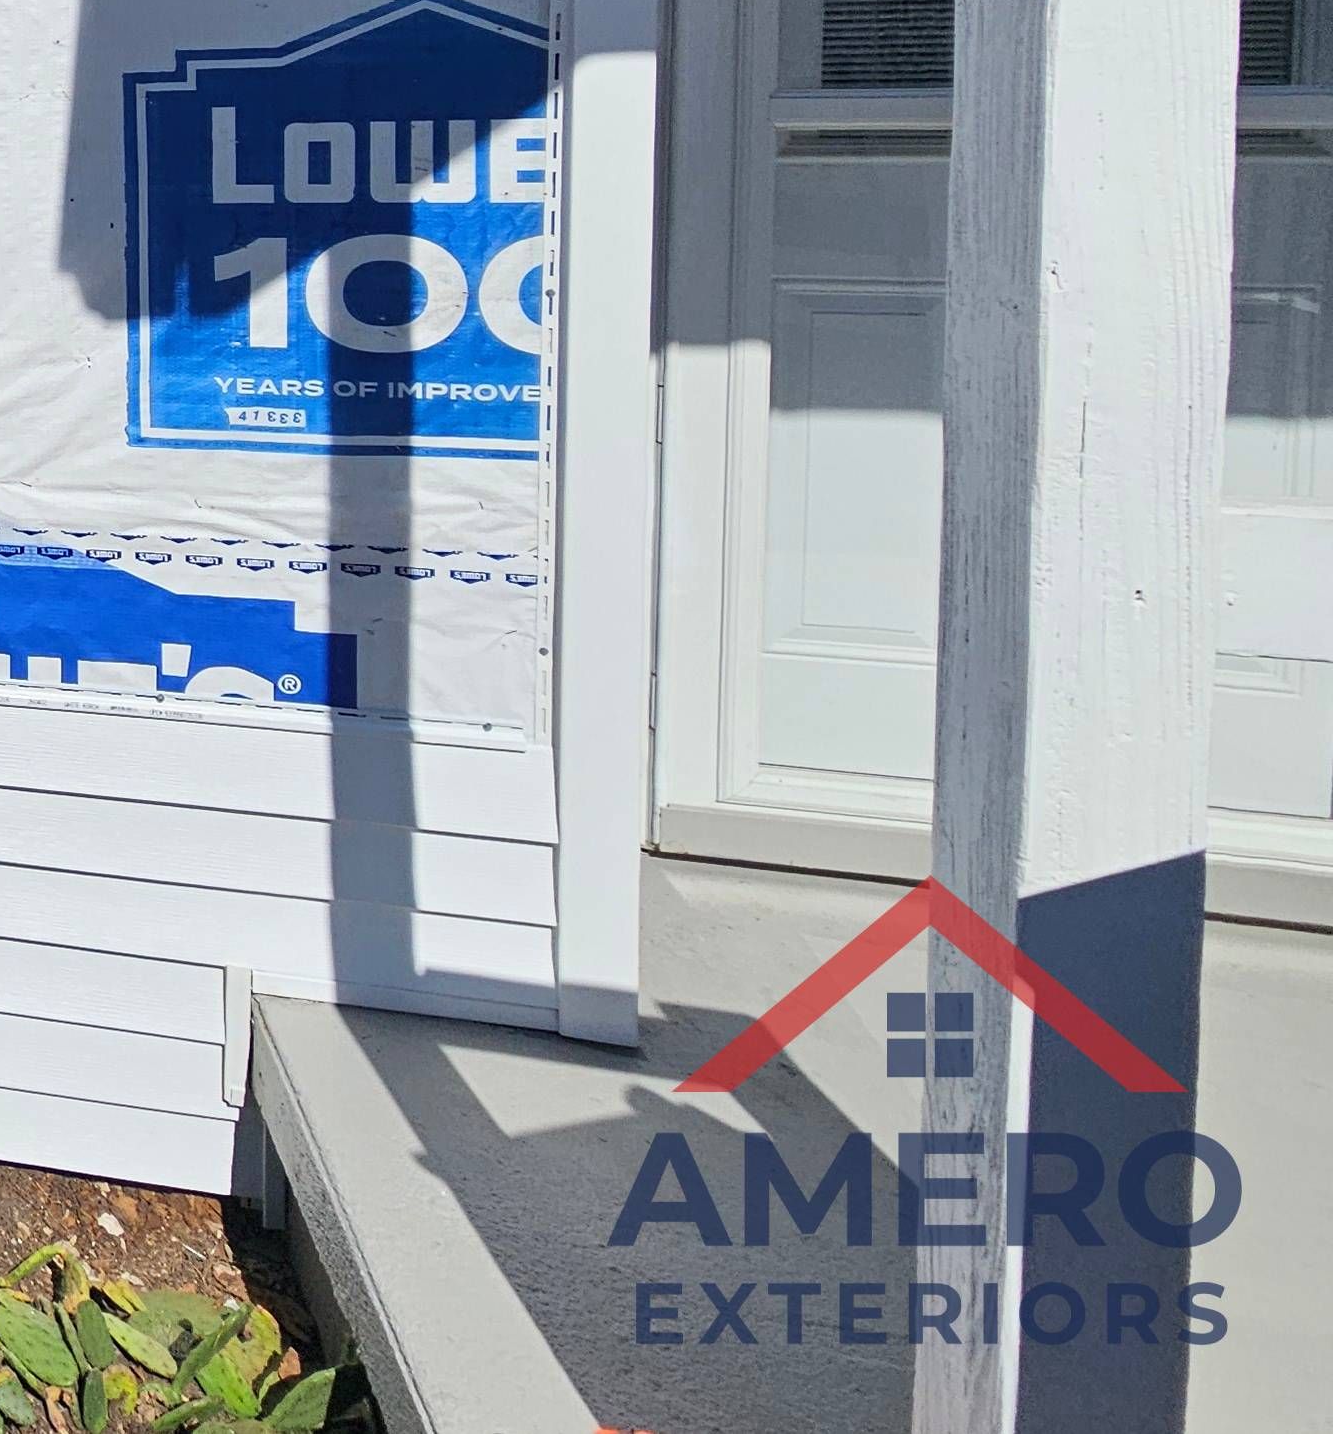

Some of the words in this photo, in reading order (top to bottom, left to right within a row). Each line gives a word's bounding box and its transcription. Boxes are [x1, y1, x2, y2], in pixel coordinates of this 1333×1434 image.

[213, 376, 324, 397] YEARS
[333, 380, 379, 399] OF
[388, 381, 541, 402] IMPROVE
